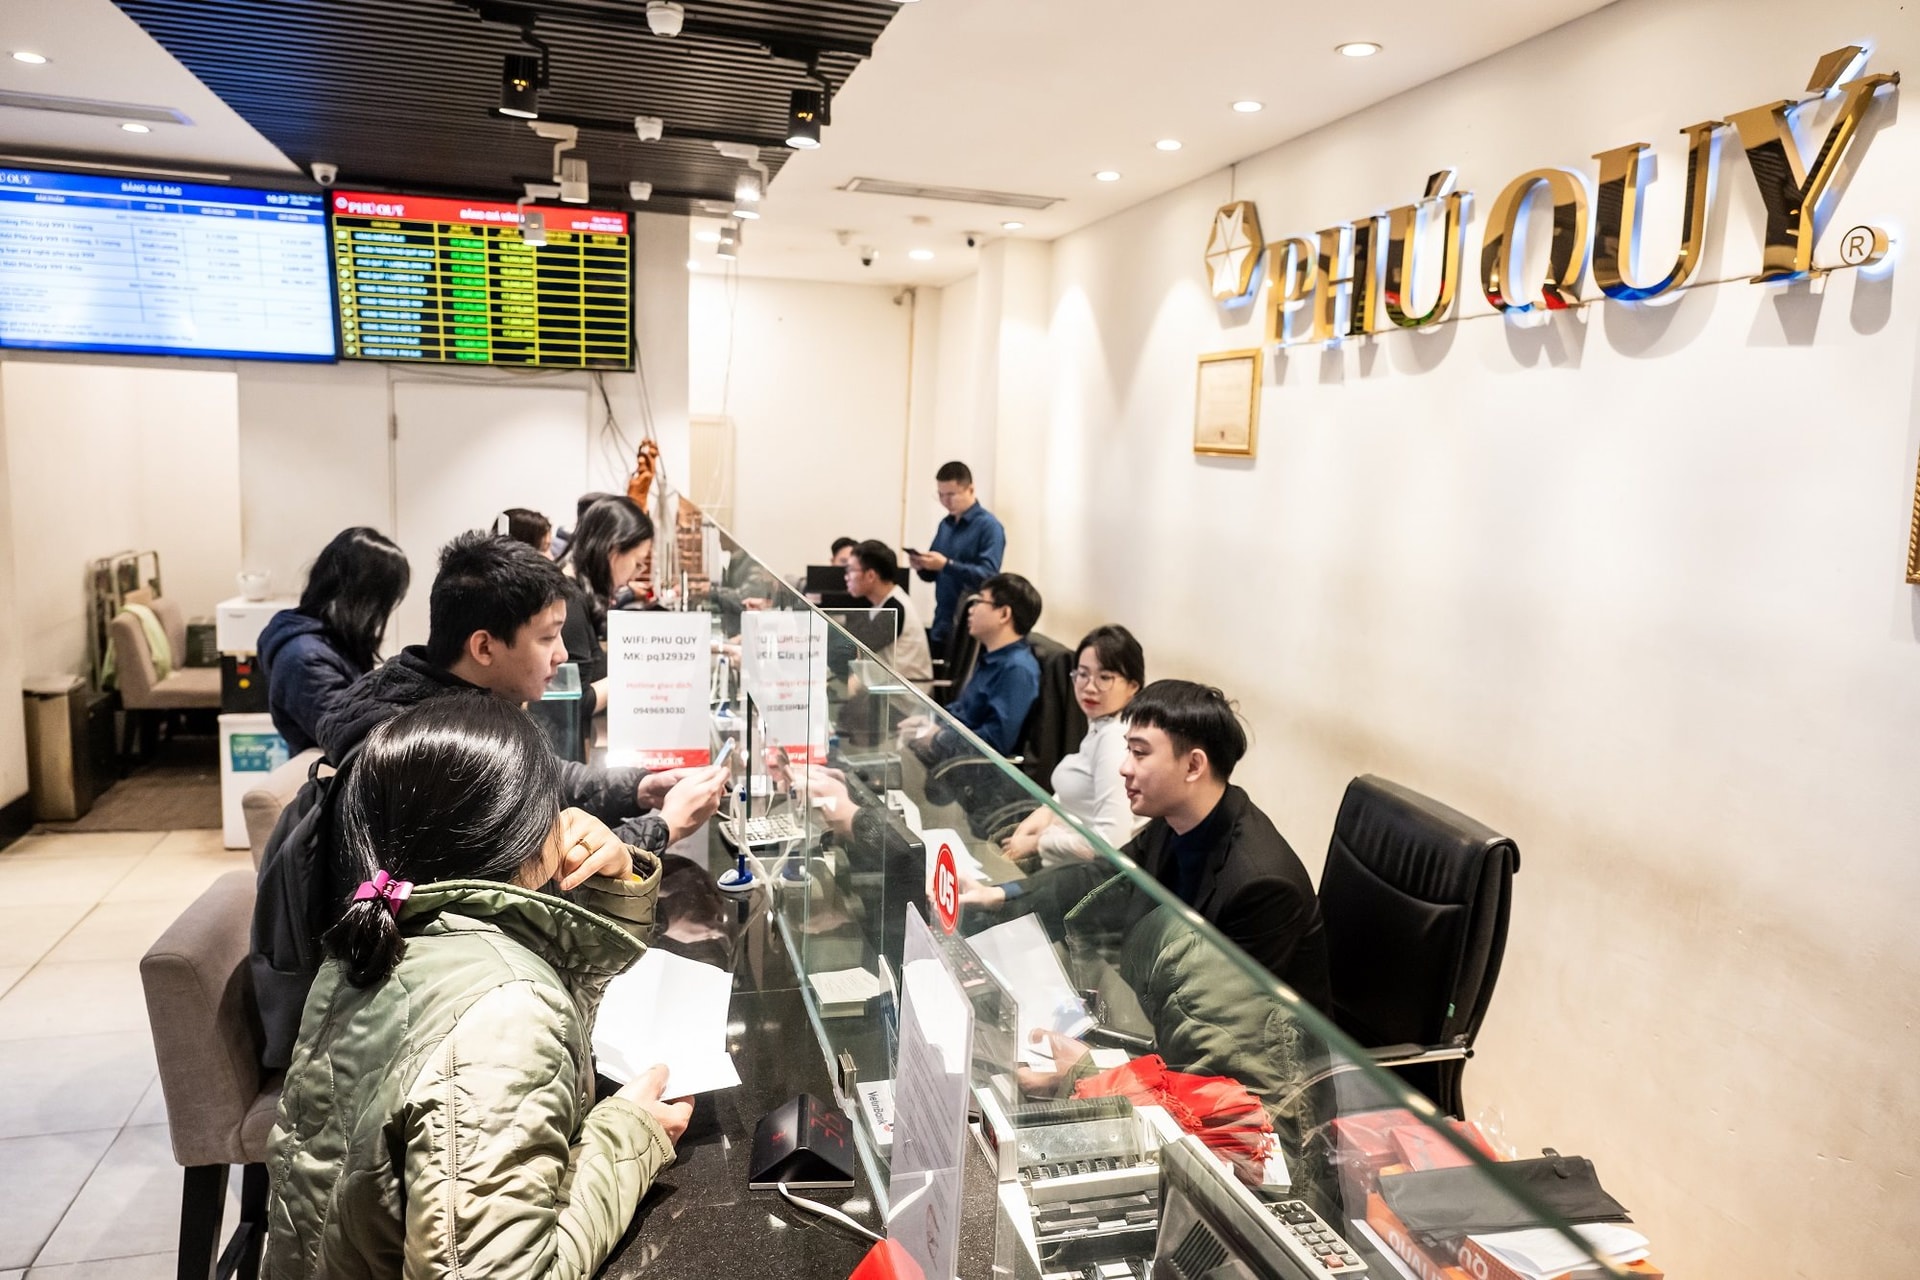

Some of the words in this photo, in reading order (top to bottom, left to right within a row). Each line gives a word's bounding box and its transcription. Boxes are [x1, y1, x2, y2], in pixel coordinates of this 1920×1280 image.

[1264, 169, 1474, 348] PHÚ
[1481, 44, 1900, 316] QUÝ
[622, 636, 648, 644] WIFI:
[651, 636, 672, 644] PHU
[675, 636, 697, 645] QUY
[623, 652, 643, 660] MK:
[646, 652, 696, 662] pq329329
[938, 864, 954, 917] 05
